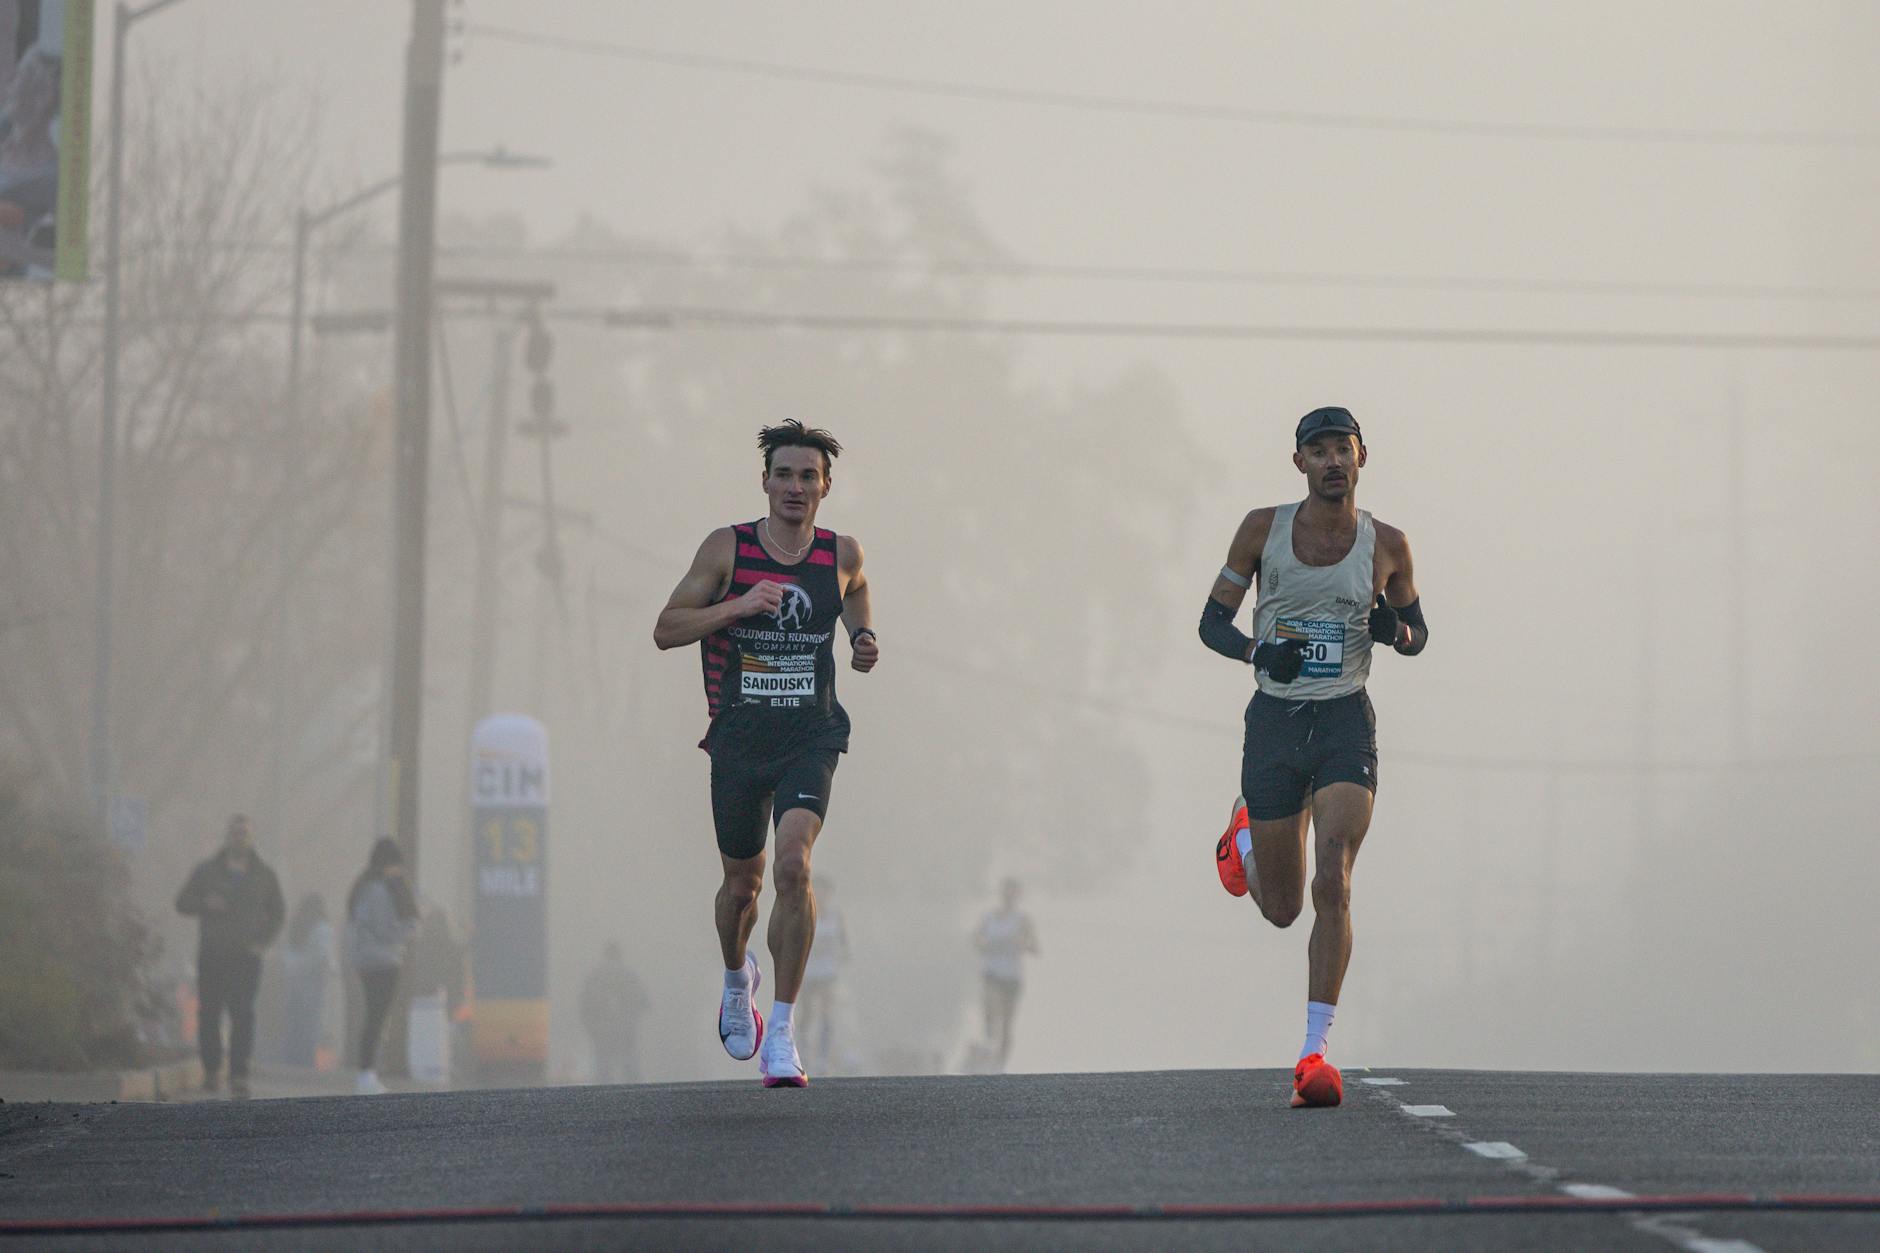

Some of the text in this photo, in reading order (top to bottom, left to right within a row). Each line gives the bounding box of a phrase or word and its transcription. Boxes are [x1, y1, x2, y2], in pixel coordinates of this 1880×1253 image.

[1308, 621, 1344, 629] CALIFORNIA
[728, 626, 785, 642] COLUMBUS
[1295, 627, 1343, 635] INTERNATIONAL
[1308, 633, 1344, 641] MARATHON
[754, 642, 806, 652] COMPANY
[780, 665, 815, 673] MARATHON
[743, 676, 814, 691] SANDUSKY
[770, 697, 800, 707] ELITE
